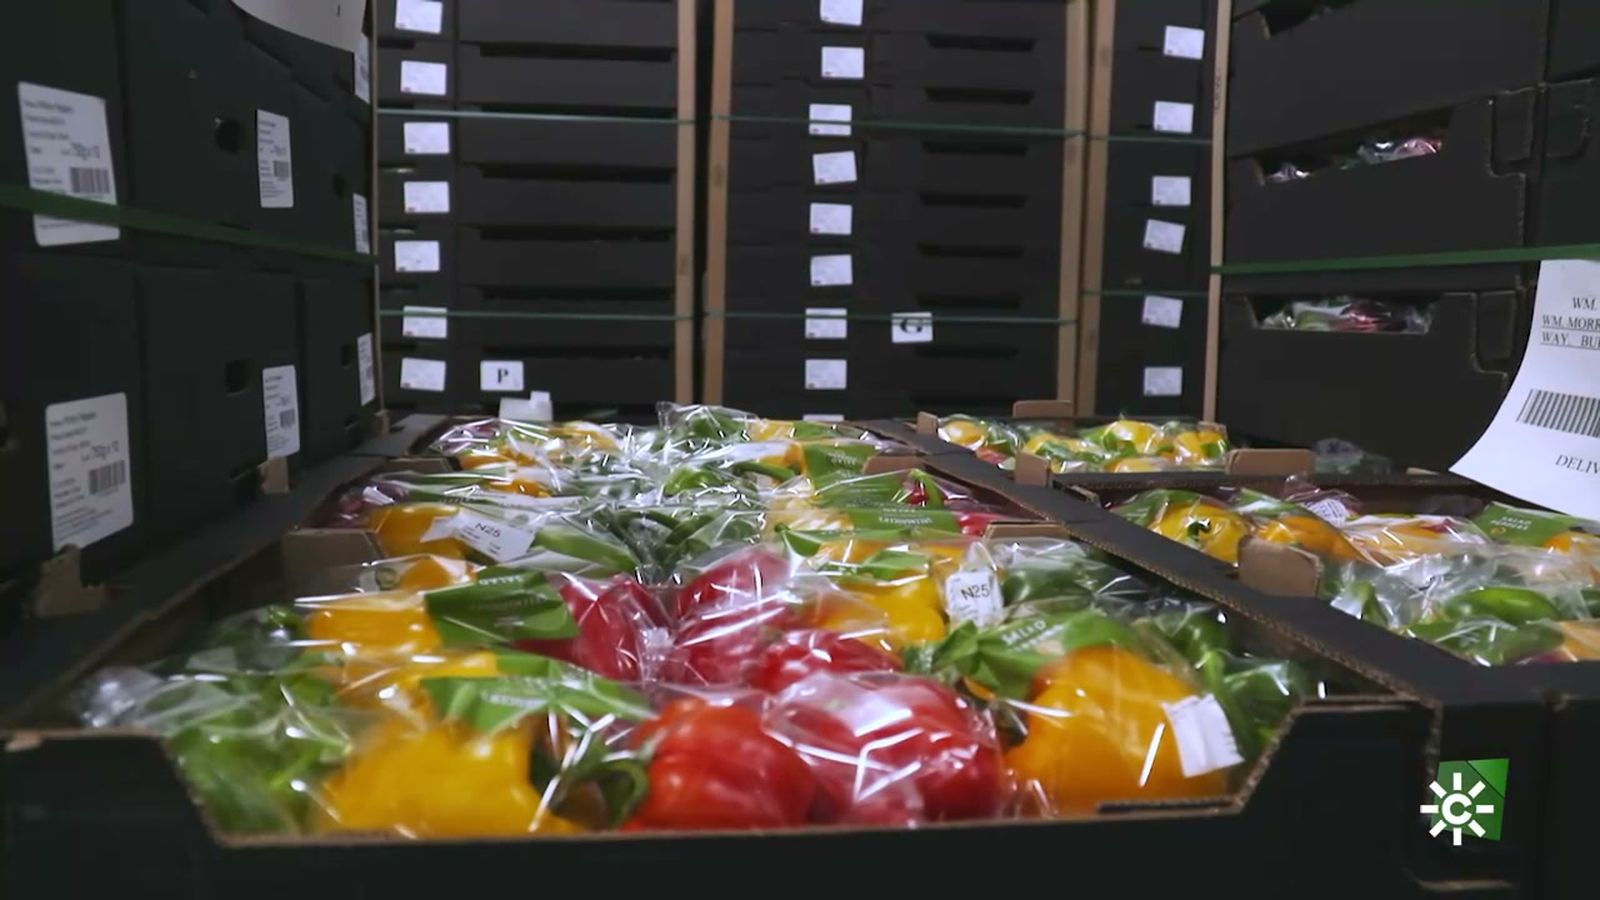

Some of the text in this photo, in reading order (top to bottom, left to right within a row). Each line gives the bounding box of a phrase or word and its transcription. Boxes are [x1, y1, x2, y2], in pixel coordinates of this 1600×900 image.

[1541, 331, 1569, 346] WAY
[497, 368, 509, 384] P
[475, 522, 502, 539] N25
[960, 583, 990, 601] N25
